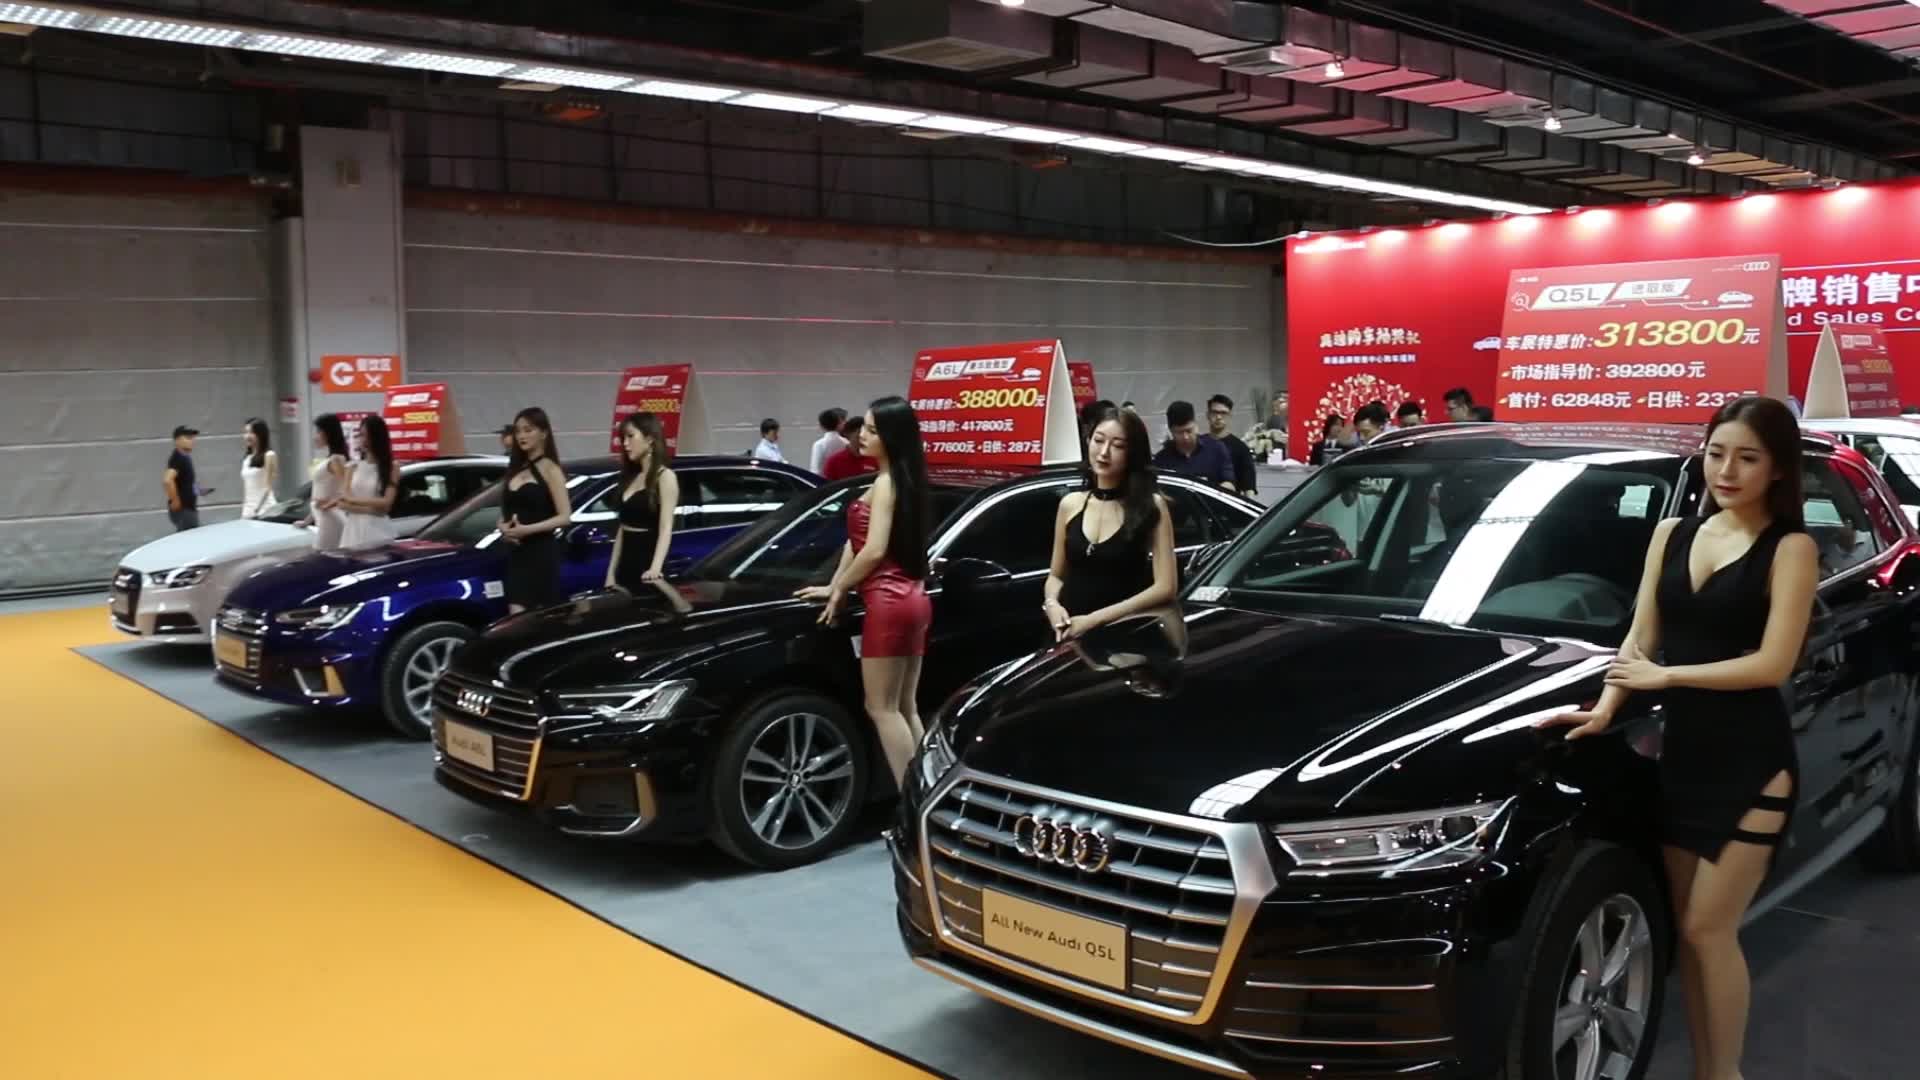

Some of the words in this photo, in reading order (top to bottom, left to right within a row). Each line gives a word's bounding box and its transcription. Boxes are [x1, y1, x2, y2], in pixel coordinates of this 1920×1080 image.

[1547, 287, 1602, 303] Q5L
[1813, 310, 1884, 325] Sales
[931, 364, 960, 377] A6L
[991, 912, 1010, 929] All
[1013, 919, 1044, 939] New
[1047, 930, 1081, 951] Audi
[1084, 942, 1117, 961] Q5L
